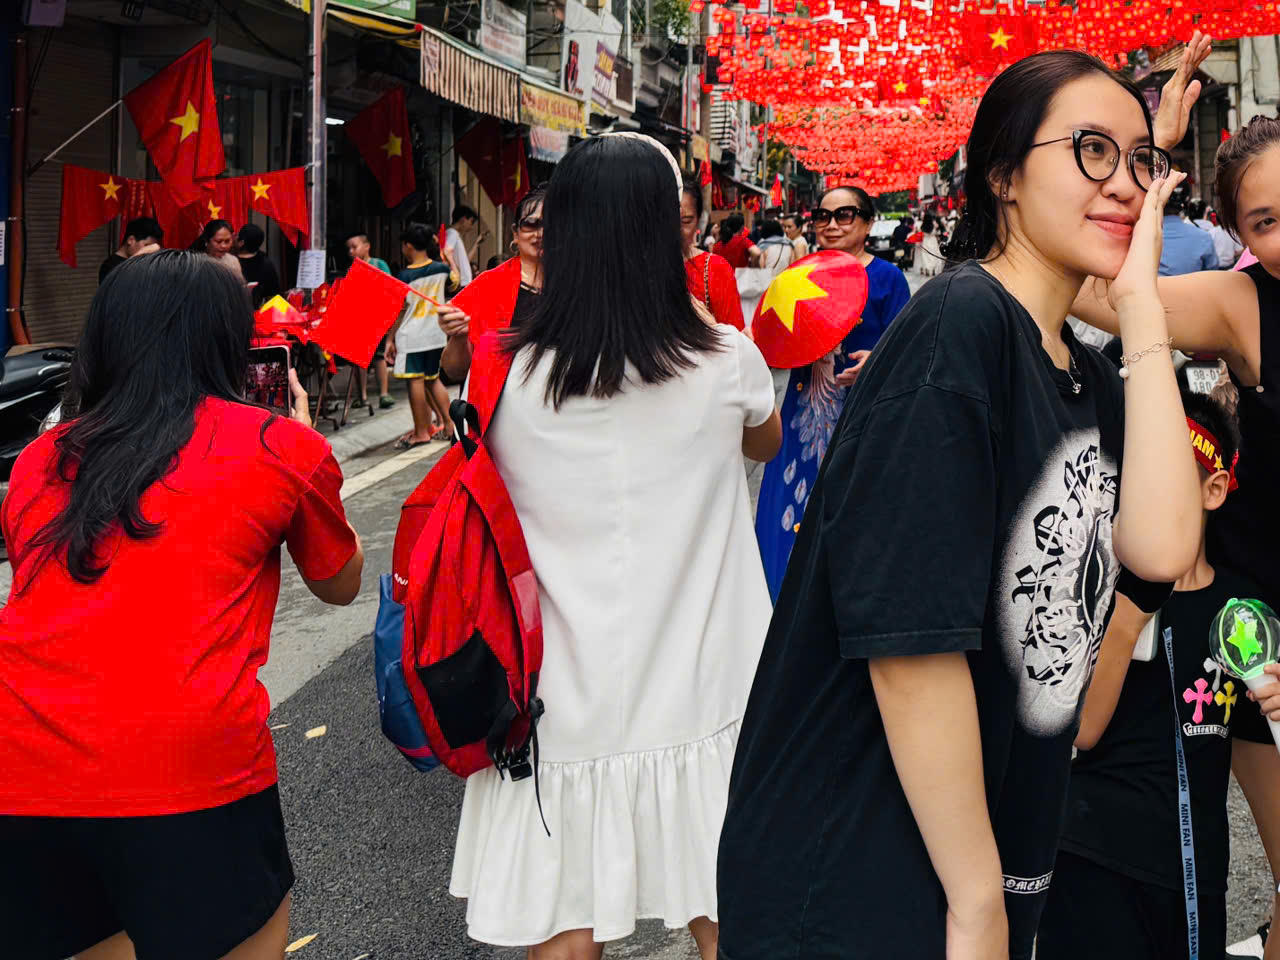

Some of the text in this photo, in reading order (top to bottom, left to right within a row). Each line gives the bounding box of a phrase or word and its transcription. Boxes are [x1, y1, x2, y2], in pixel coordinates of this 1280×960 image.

[1181, 803, 1191, 847] MINI FAN
[1184, 857, 1194, 901] MINI FAN
[1188, 911, 1198, 955] MINI FAN
